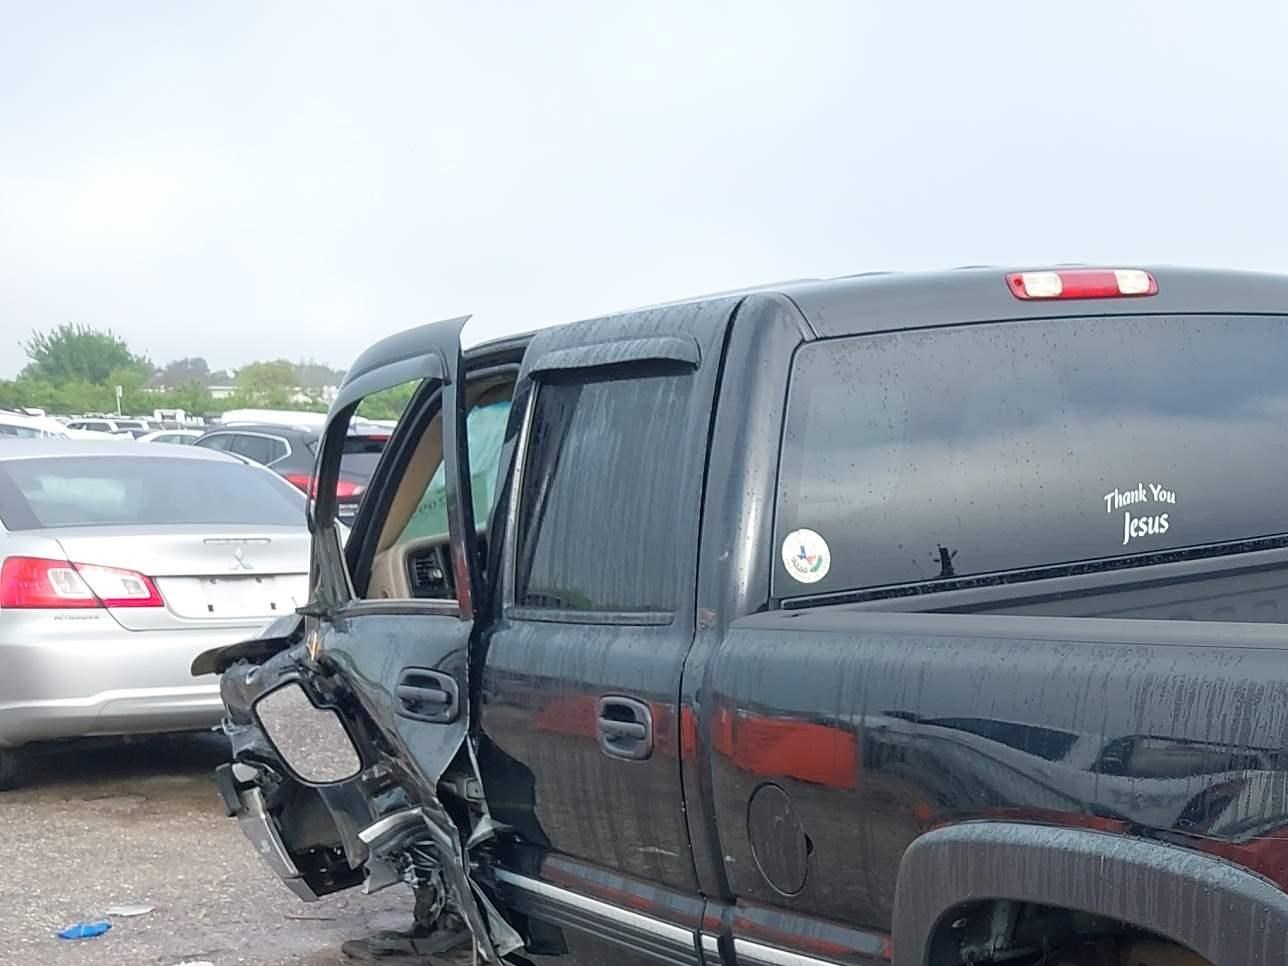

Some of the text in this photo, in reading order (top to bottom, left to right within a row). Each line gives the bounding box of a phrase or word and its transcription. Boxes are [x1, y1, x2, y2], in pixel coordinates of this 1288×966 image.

[1103, 483, 1177, 513] Thank You
[1122, 511, 1170, 545] Jesus
